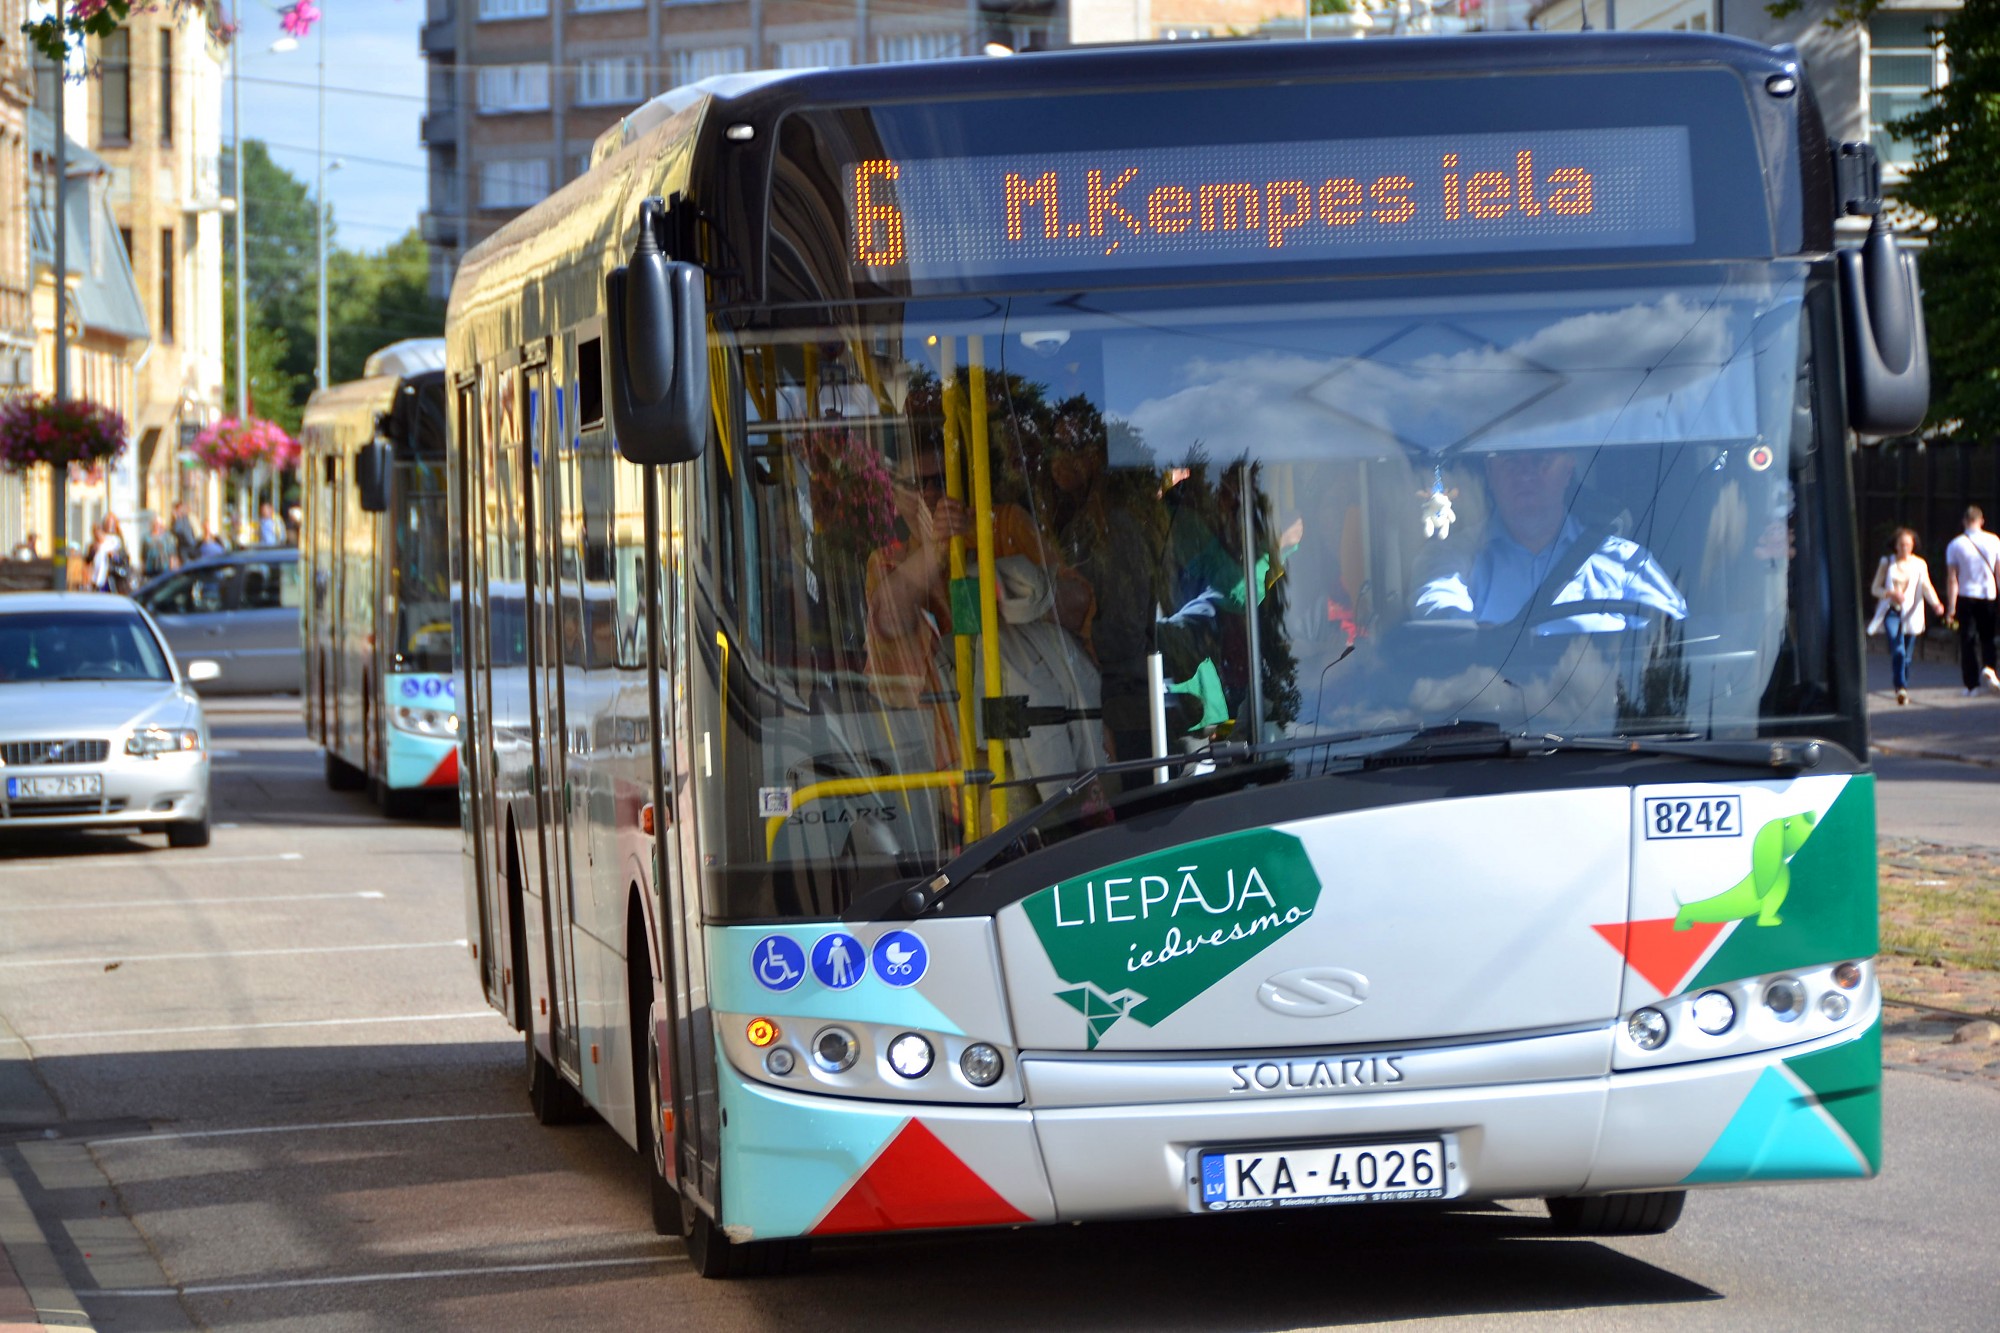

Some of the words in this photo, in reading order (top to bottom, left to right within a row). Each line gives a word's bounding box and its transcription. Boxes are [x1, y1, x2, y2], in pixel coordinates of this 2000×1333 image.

[855, 160, 902, 266] 6
[1443, 150, 1593, 220] iela
[1655, 800, 1733, 834] 8242
[1053, 865, 1277, 927] LIEPĀJA
[1127, 906, 1312, 972] iedvesmo
[1230, 1056, 1404, 1093] SOLARIS
[1206, 1182, 1225, 1195] LV
